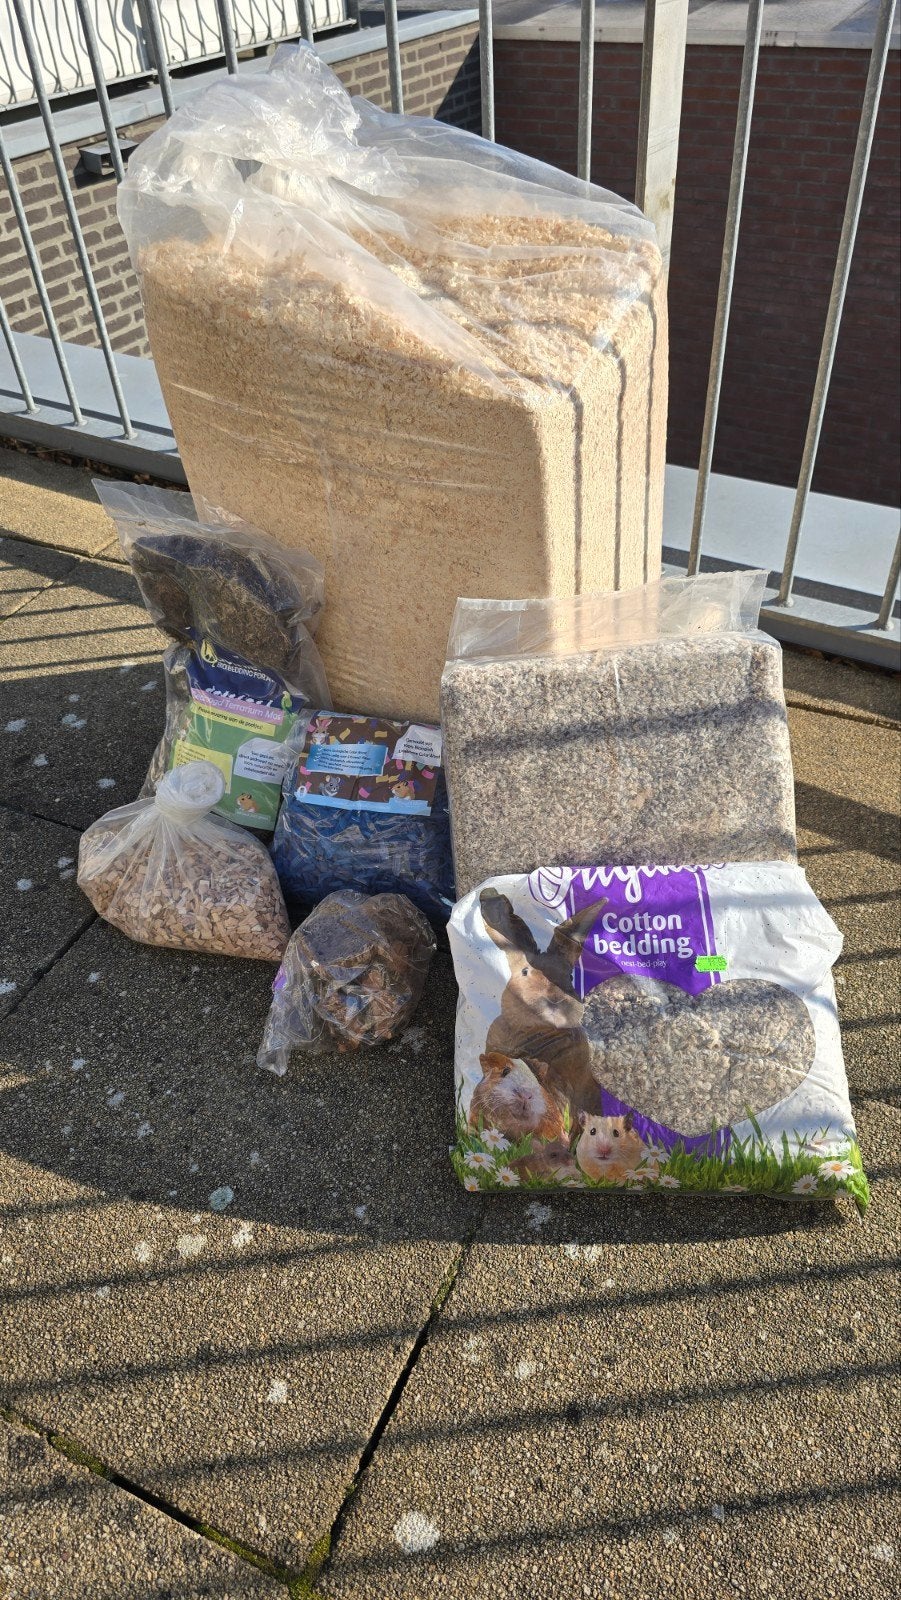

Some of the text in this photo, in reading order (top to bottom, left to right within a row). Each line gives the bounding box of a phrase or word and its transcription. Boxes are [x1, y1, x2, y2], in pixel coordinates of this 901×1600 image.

[225, 699, 264, 716] Terrarium
[602, 911, 683, 933] Cotton
[593, 934, 693, 959] bedding
